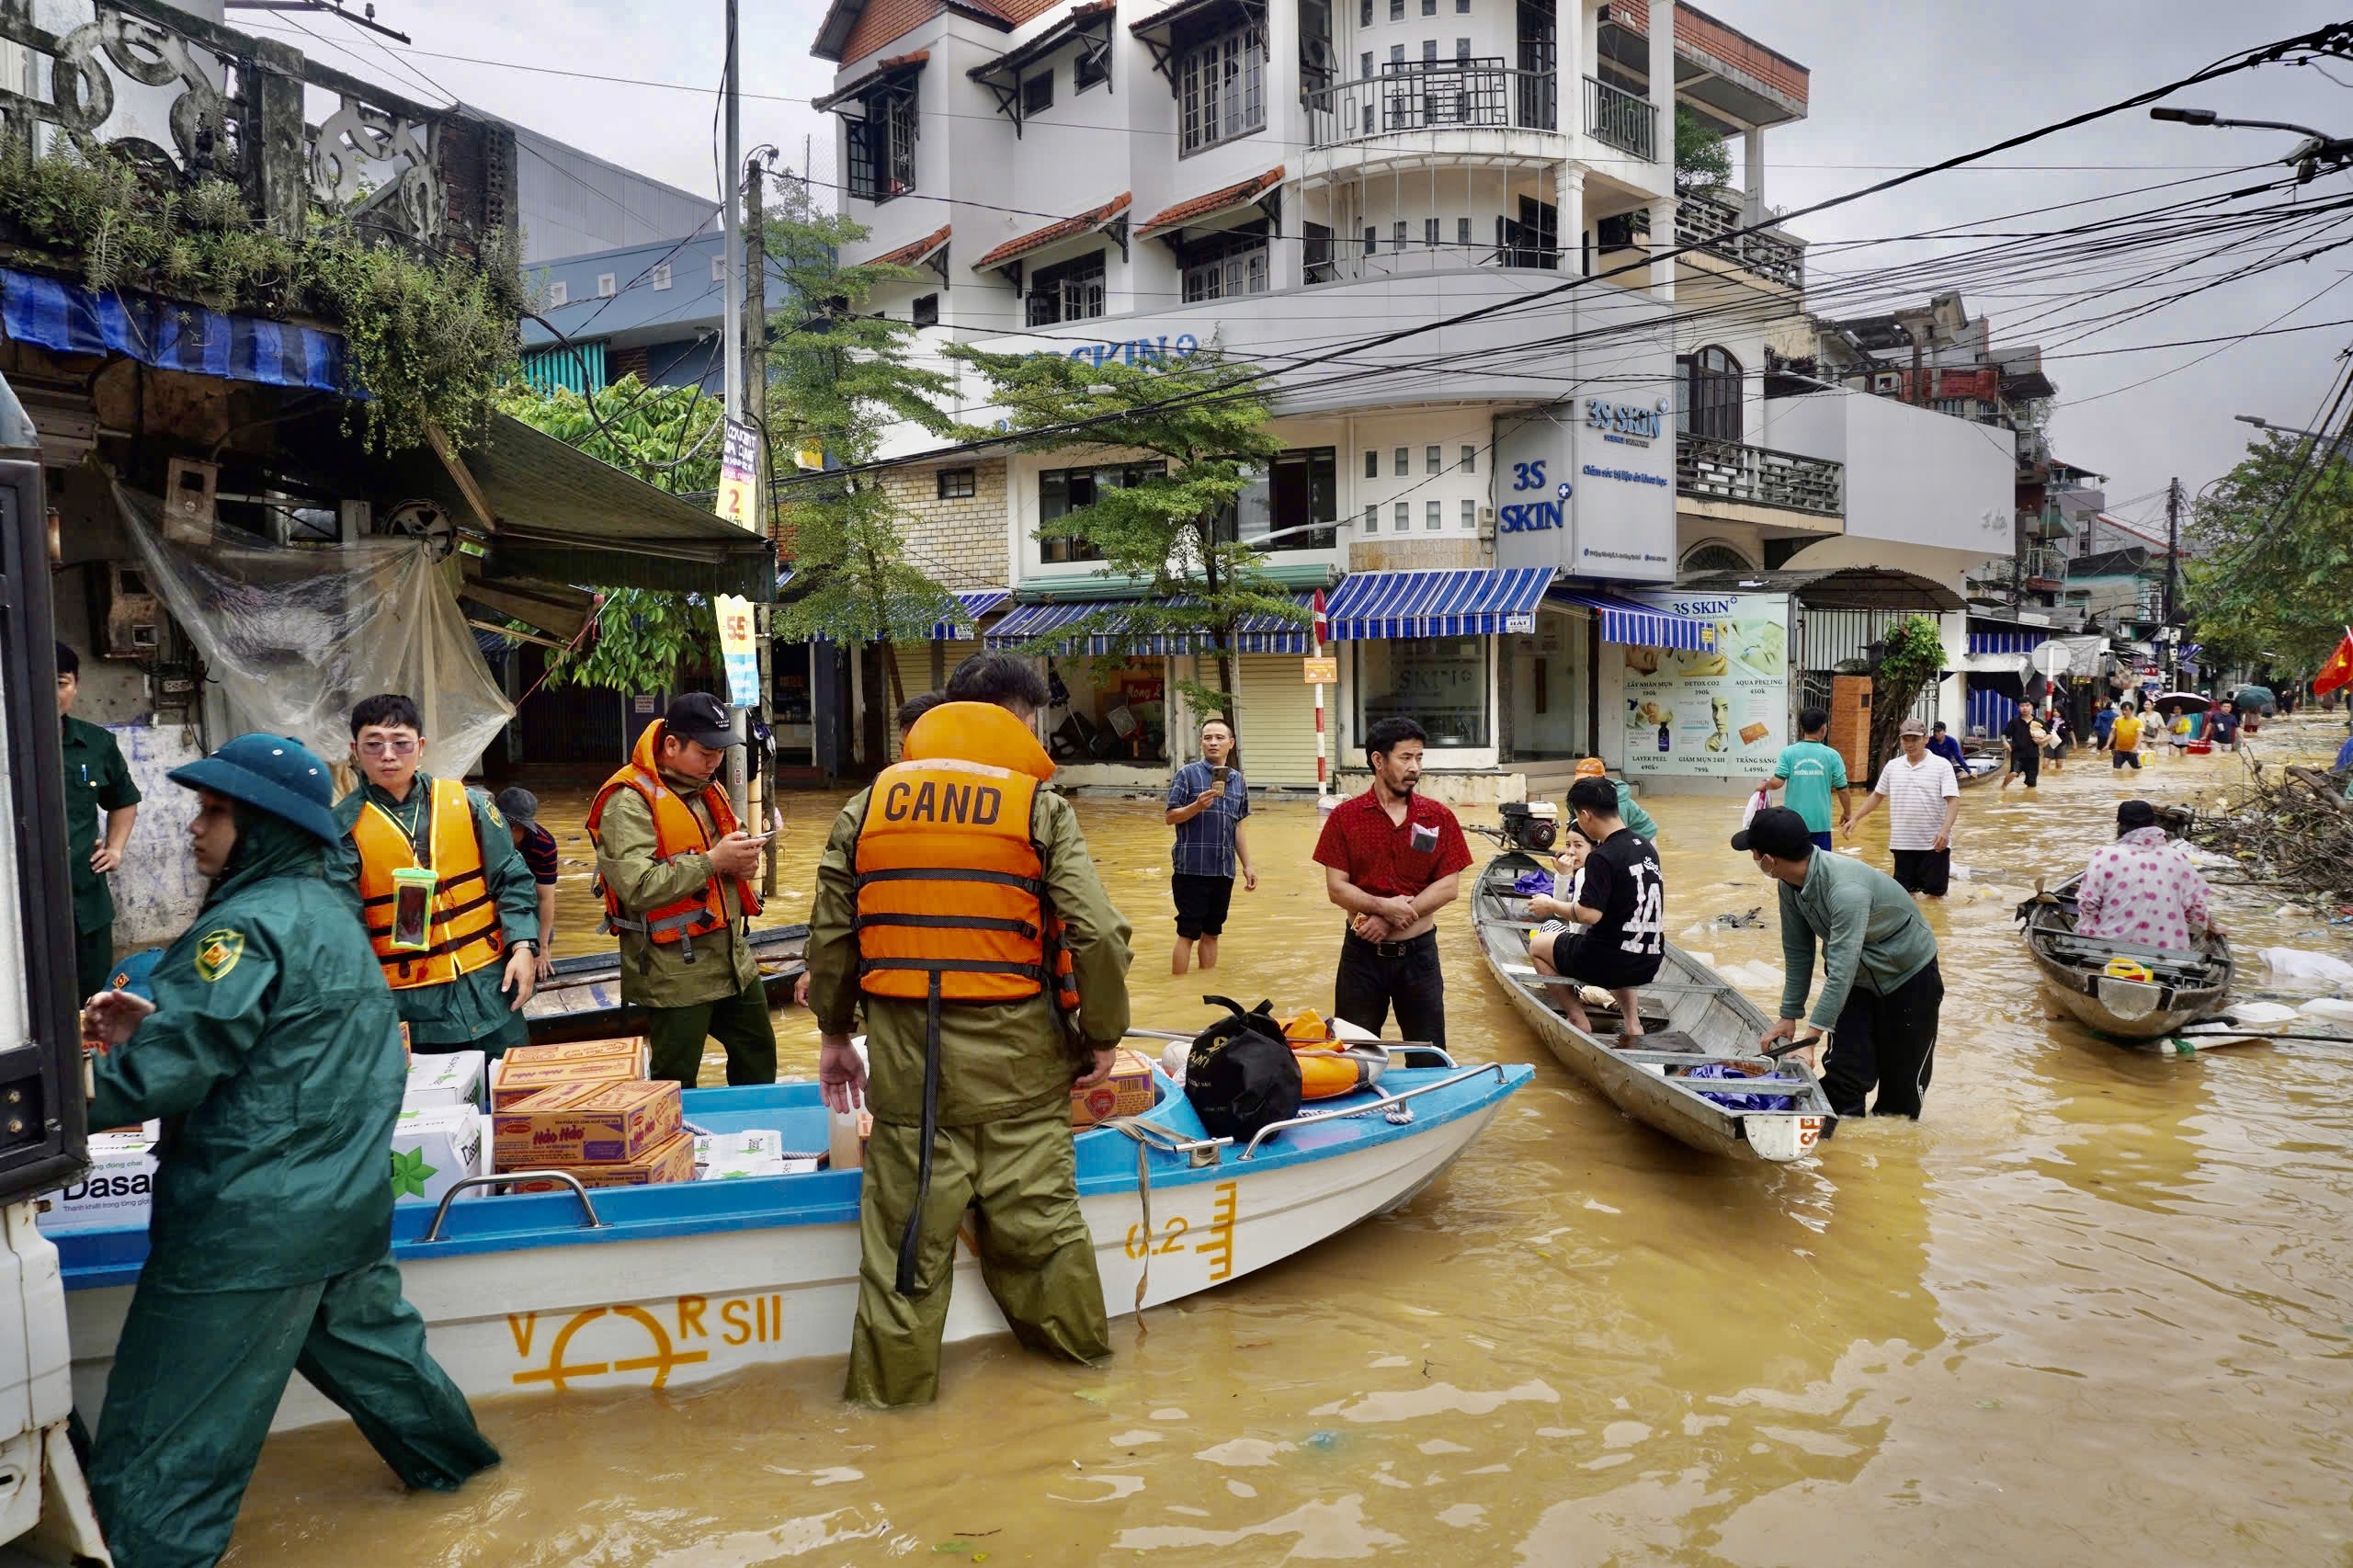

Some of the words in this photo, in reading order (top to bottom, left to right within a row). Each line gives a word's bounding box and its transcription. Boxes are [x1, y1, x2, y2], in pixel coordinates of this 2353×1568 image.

[1586, 398, 1613, 429] 3S
[1614, 404, 1661, 439] SKIN
[1513, 460, 1546, 491] 3S
[729, 488, 740, 514] 2
[1500, 499, 1565, 533] SKIN
[1673, 602, 1690, 615] 3S
[1691, 600, 1729, 615] SKIN
[885, 782, 1001, 824] CAND
[533, 1127, 558, 1146] Hảo
[559, 1124, 586, 1142] Hảo
[102, 1201, 119, 1210] trong
[1125, 1217, 1188, 1259] 0.2
[507, 1312, 535, 1358] V
[678, 1294, 708, 1339] R
